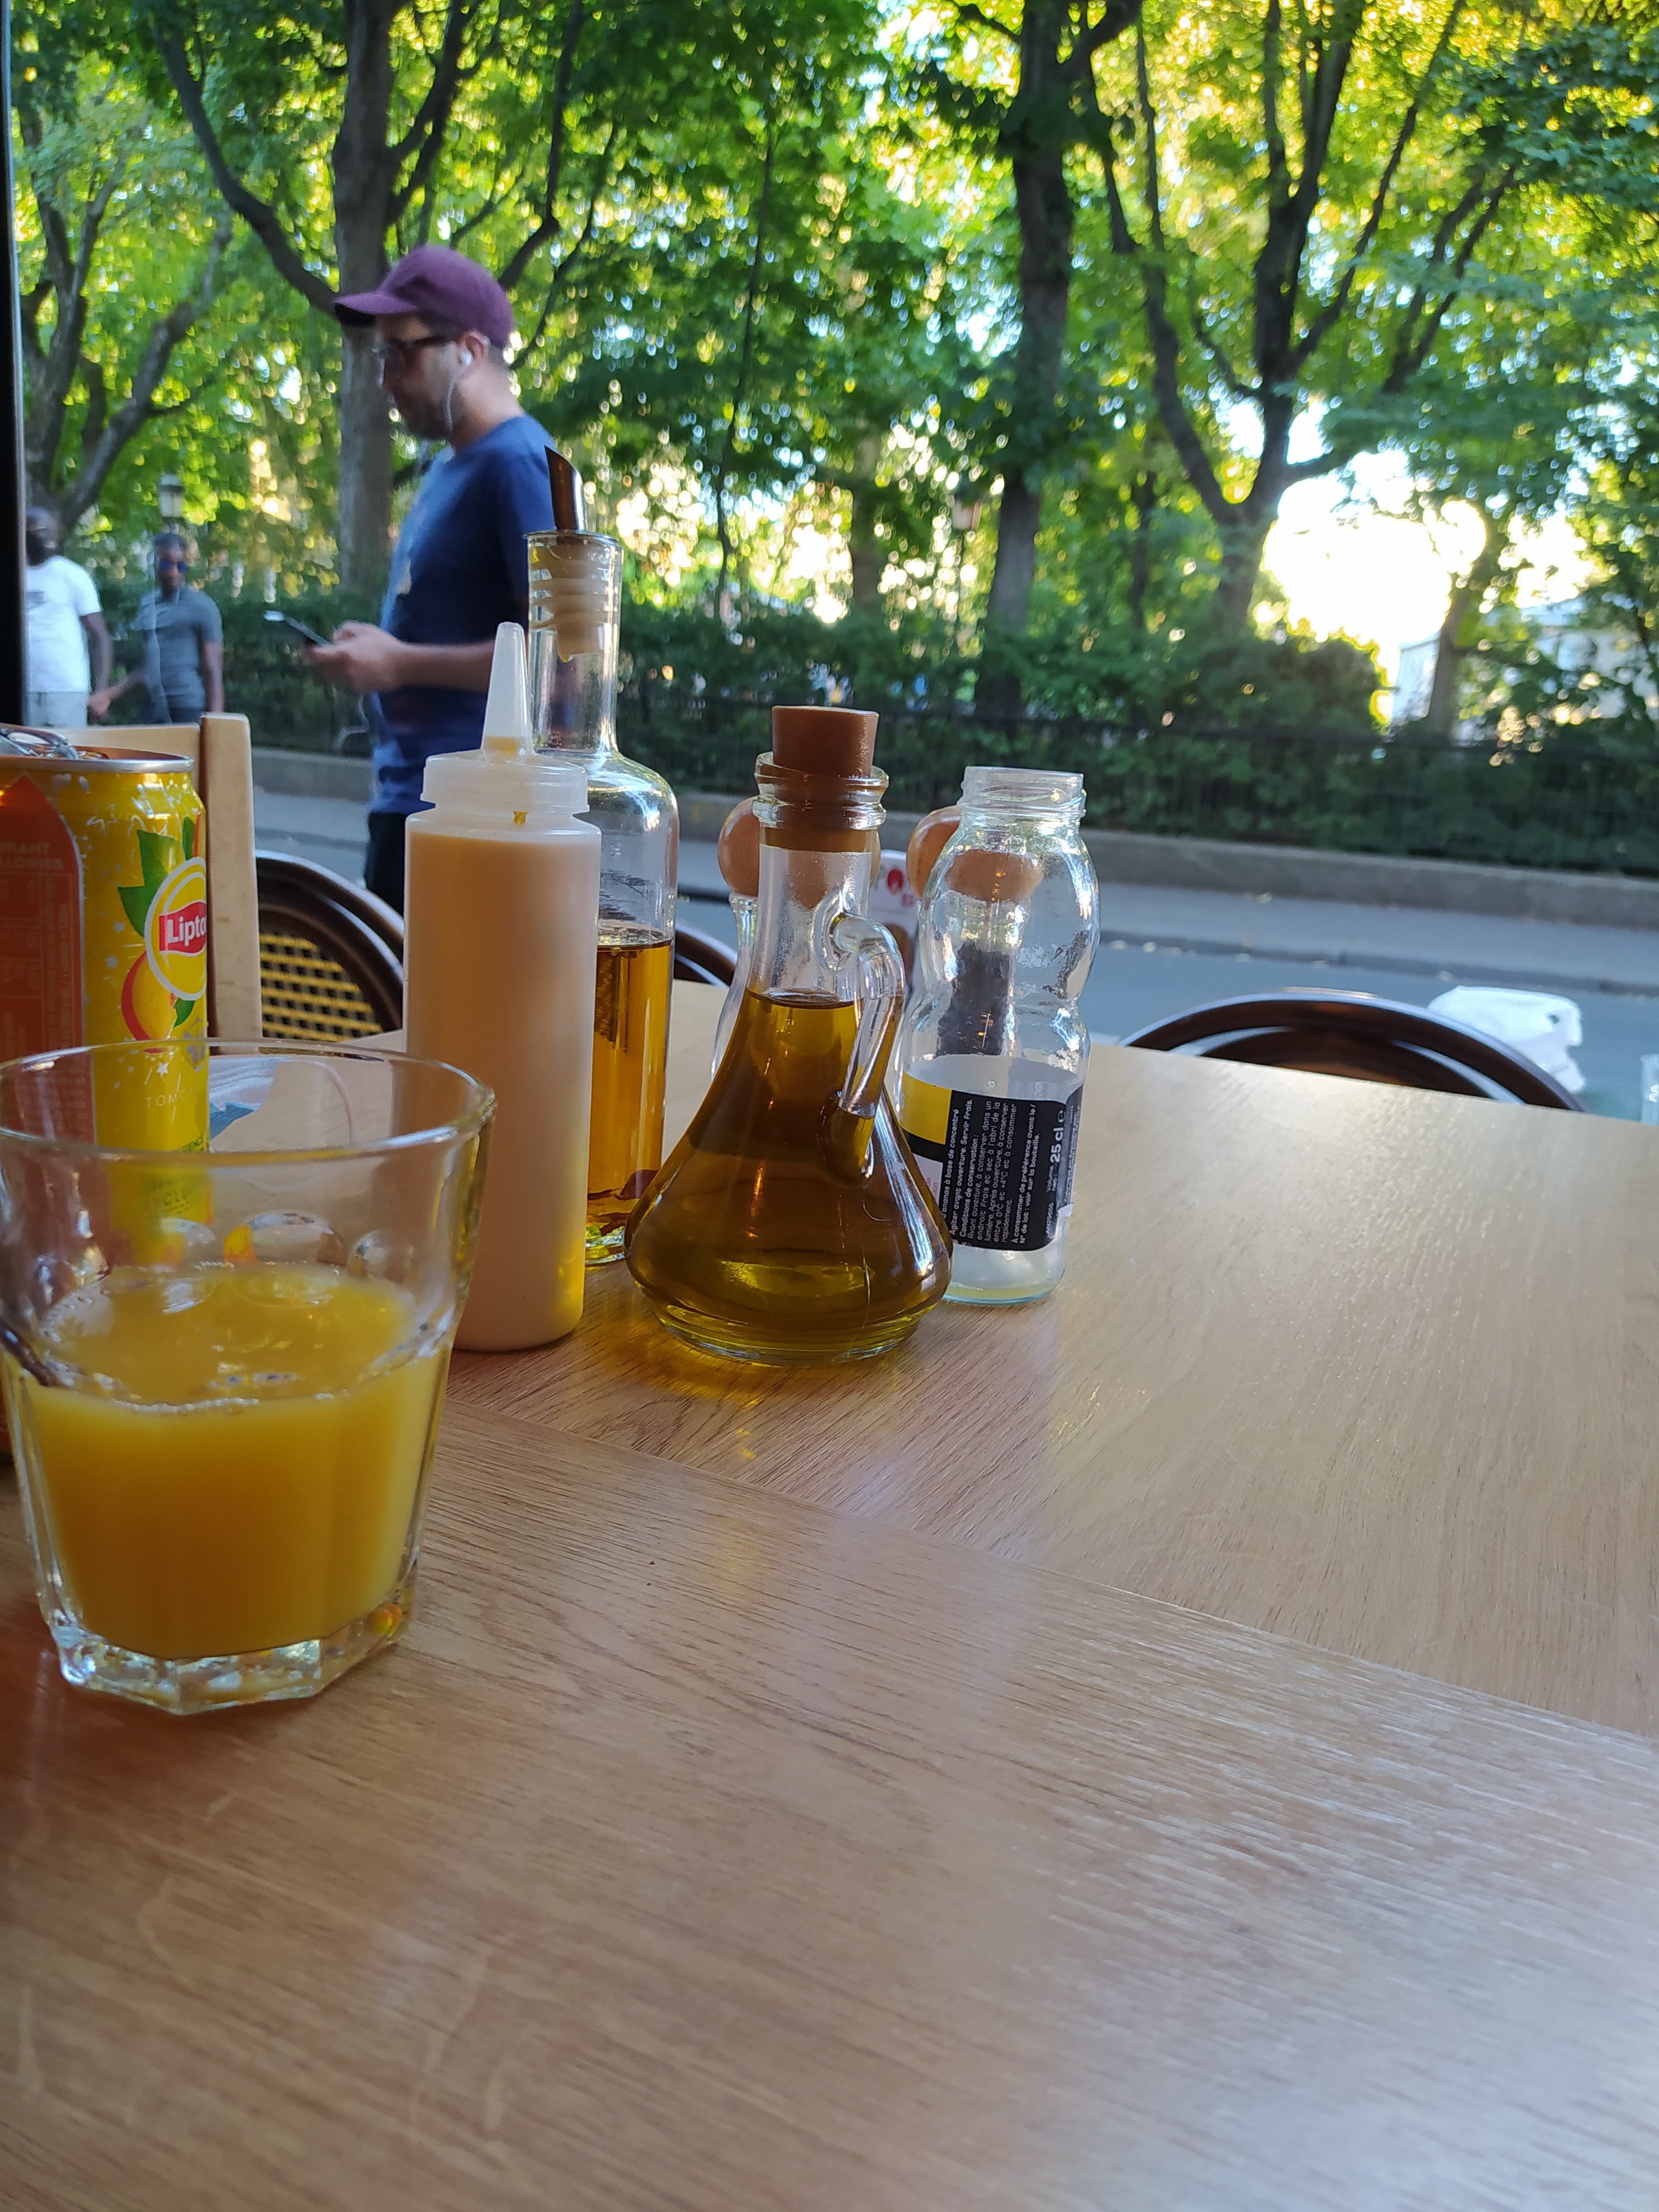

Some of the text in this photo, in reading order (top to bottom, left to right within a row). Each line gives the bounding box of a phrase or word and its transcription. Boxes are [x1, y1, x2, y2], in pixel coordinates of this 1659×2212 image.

[168, 915, 206, 947] Lipto
[985, 1101, 992, 1110] un
[950, 1109, 959, 1147] concentré
[961, 1121, 969, 1145] Servir
[982, 1112, 990, 1131] dans
[999, 1103, 1009, 1140] conserver
[1006, 1103, 1017, 1149] consommer
[1053, 1128, 1064, 1141] cl
[947, 1150, 954, 1159] de
[968, 1139, 979, 1187] conservation
[977, 1133, 987, 1172] conserver
[1003, 1159, 1010, 1168] et
[1021, 1140, 1031, 1182] préférence
[1050, 1144, 1062, 1162] 25
[957, 1146, 967, 1186] ouverture.
[976, 1210, 986, 1240] endroit
[984, 1175, 990, 1184] et
[992, 1113, 999, 1123] de
[964, 1188, 972, 1197] de
[999, 1191, 1005, 1201] et
[1019, 1183, 1025, 1193] de
[1021, 1224, 1027, 1233] de
[1029, 1133, 1040, 1167] bouteille.
[988, 1190, 998, 1212] Après
[950, 1211, 958, 1236] Agiter
[959, 1199, 971, 1237] Conditions
[967, 1219, 977, 1238] Avant
[984, 1213, 994, 1241] lumière.
[1001, 1198, 1013, 1243] rapidement.
[1014, 1194, 1024, 1237] consommer
[993, 1220, 1001, 1242] entre
